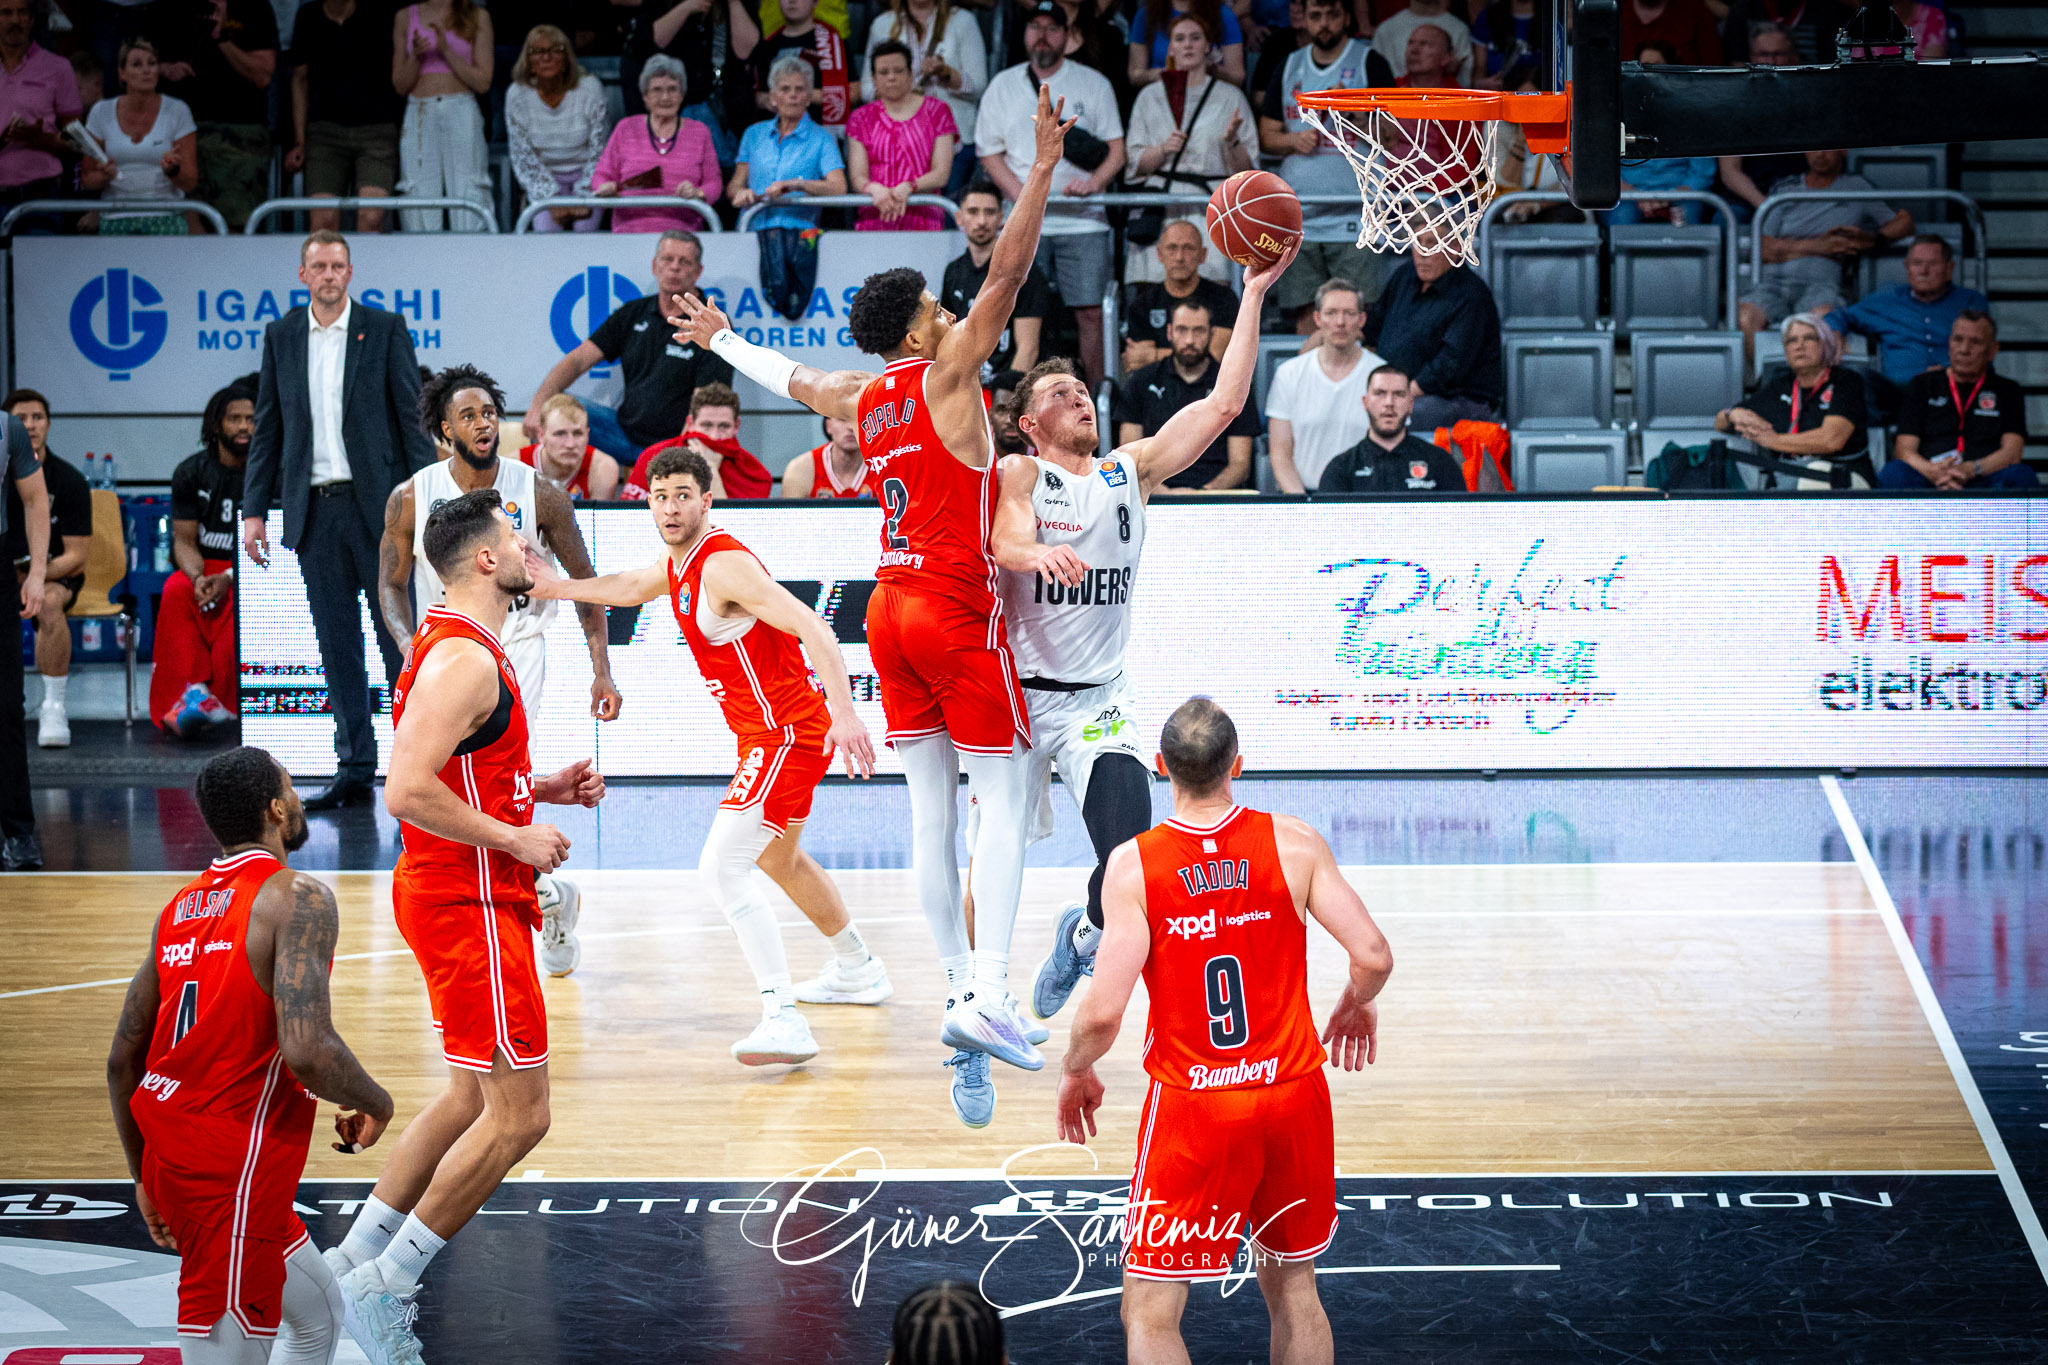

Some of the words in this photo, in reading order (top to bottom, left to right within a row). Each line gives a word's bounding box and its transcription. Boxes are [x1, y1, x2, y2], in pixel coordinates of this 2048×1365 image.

[1254, 232, 1289, 254] SPAL
[221, 499, 233, 522] 3
[883, 478, 909, 550] 2
[1044, 521, 1083, 532] VEOLIA
[1117, 503, 1131, 544] 8
[1820, 656, 2048, 710] elektro
[1178, 860, 1249, 897] TADDA
[173, 888, 235, 926] NELSON
[1166, 909, 1216, 940] xpd
[1226, 910, 1271, 926] logistics
[161, 937, 196, 967] xpd
[1204, 955, 1249, 1050] 9
[1188, 1057, 1278, 1090] Bamberg
